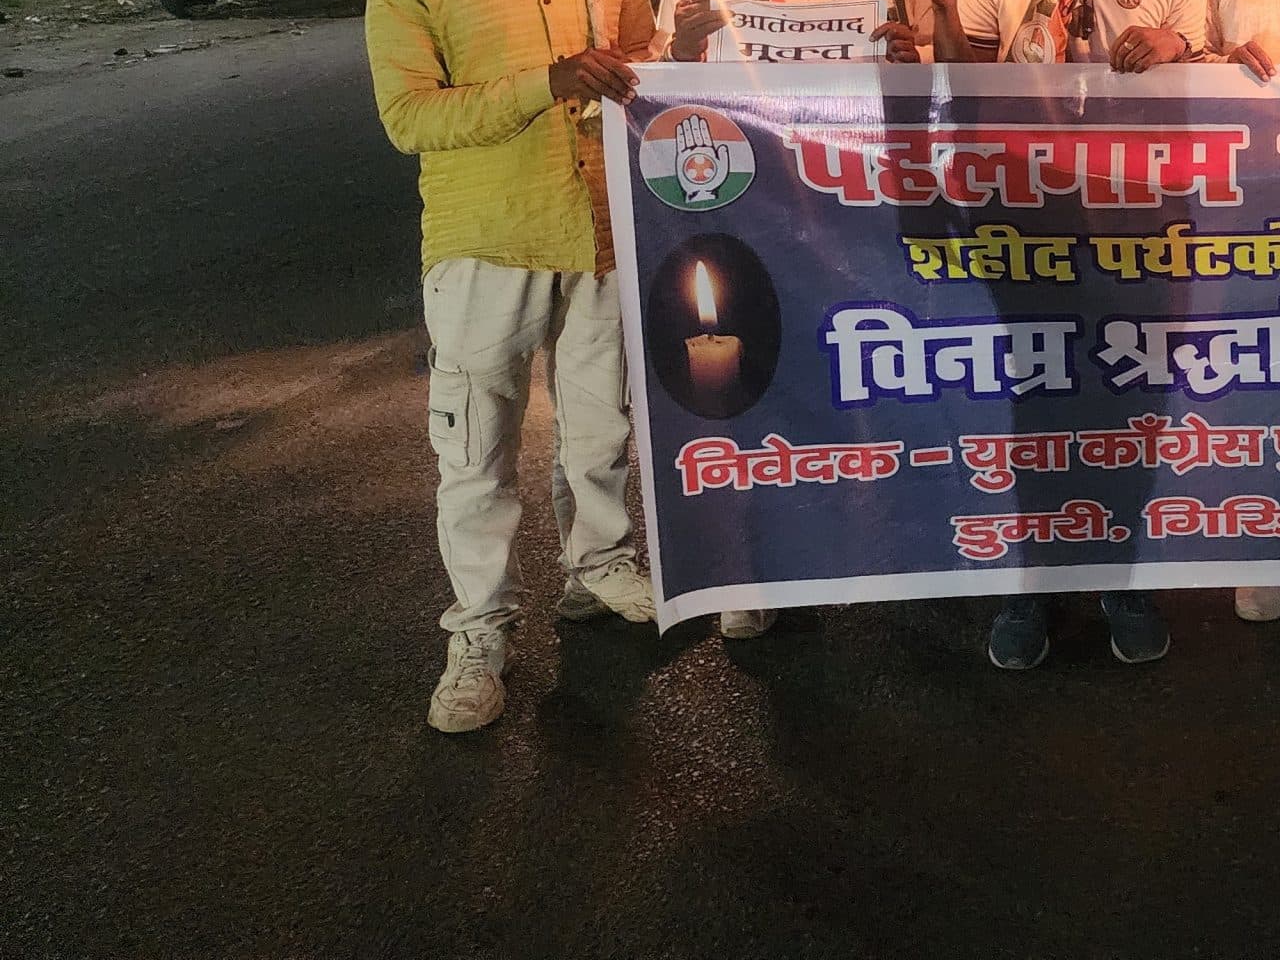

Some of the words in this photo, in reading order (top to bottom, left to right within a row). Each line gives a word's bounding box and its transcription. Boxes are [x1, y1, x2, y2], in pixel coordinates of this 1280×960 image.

[732, 12, 866, 34] आतंकवाद
[785, 123, 1250, 208] पहलगाम
[902, 225, 1077, 280] शहीद
[826, 307, 1078, 402] विनम्र
[675, 433, 902, 497] निवेदक
[960, 432, 1073, 493] युवा
[952, 499, 1133, 561] डुमरी,
